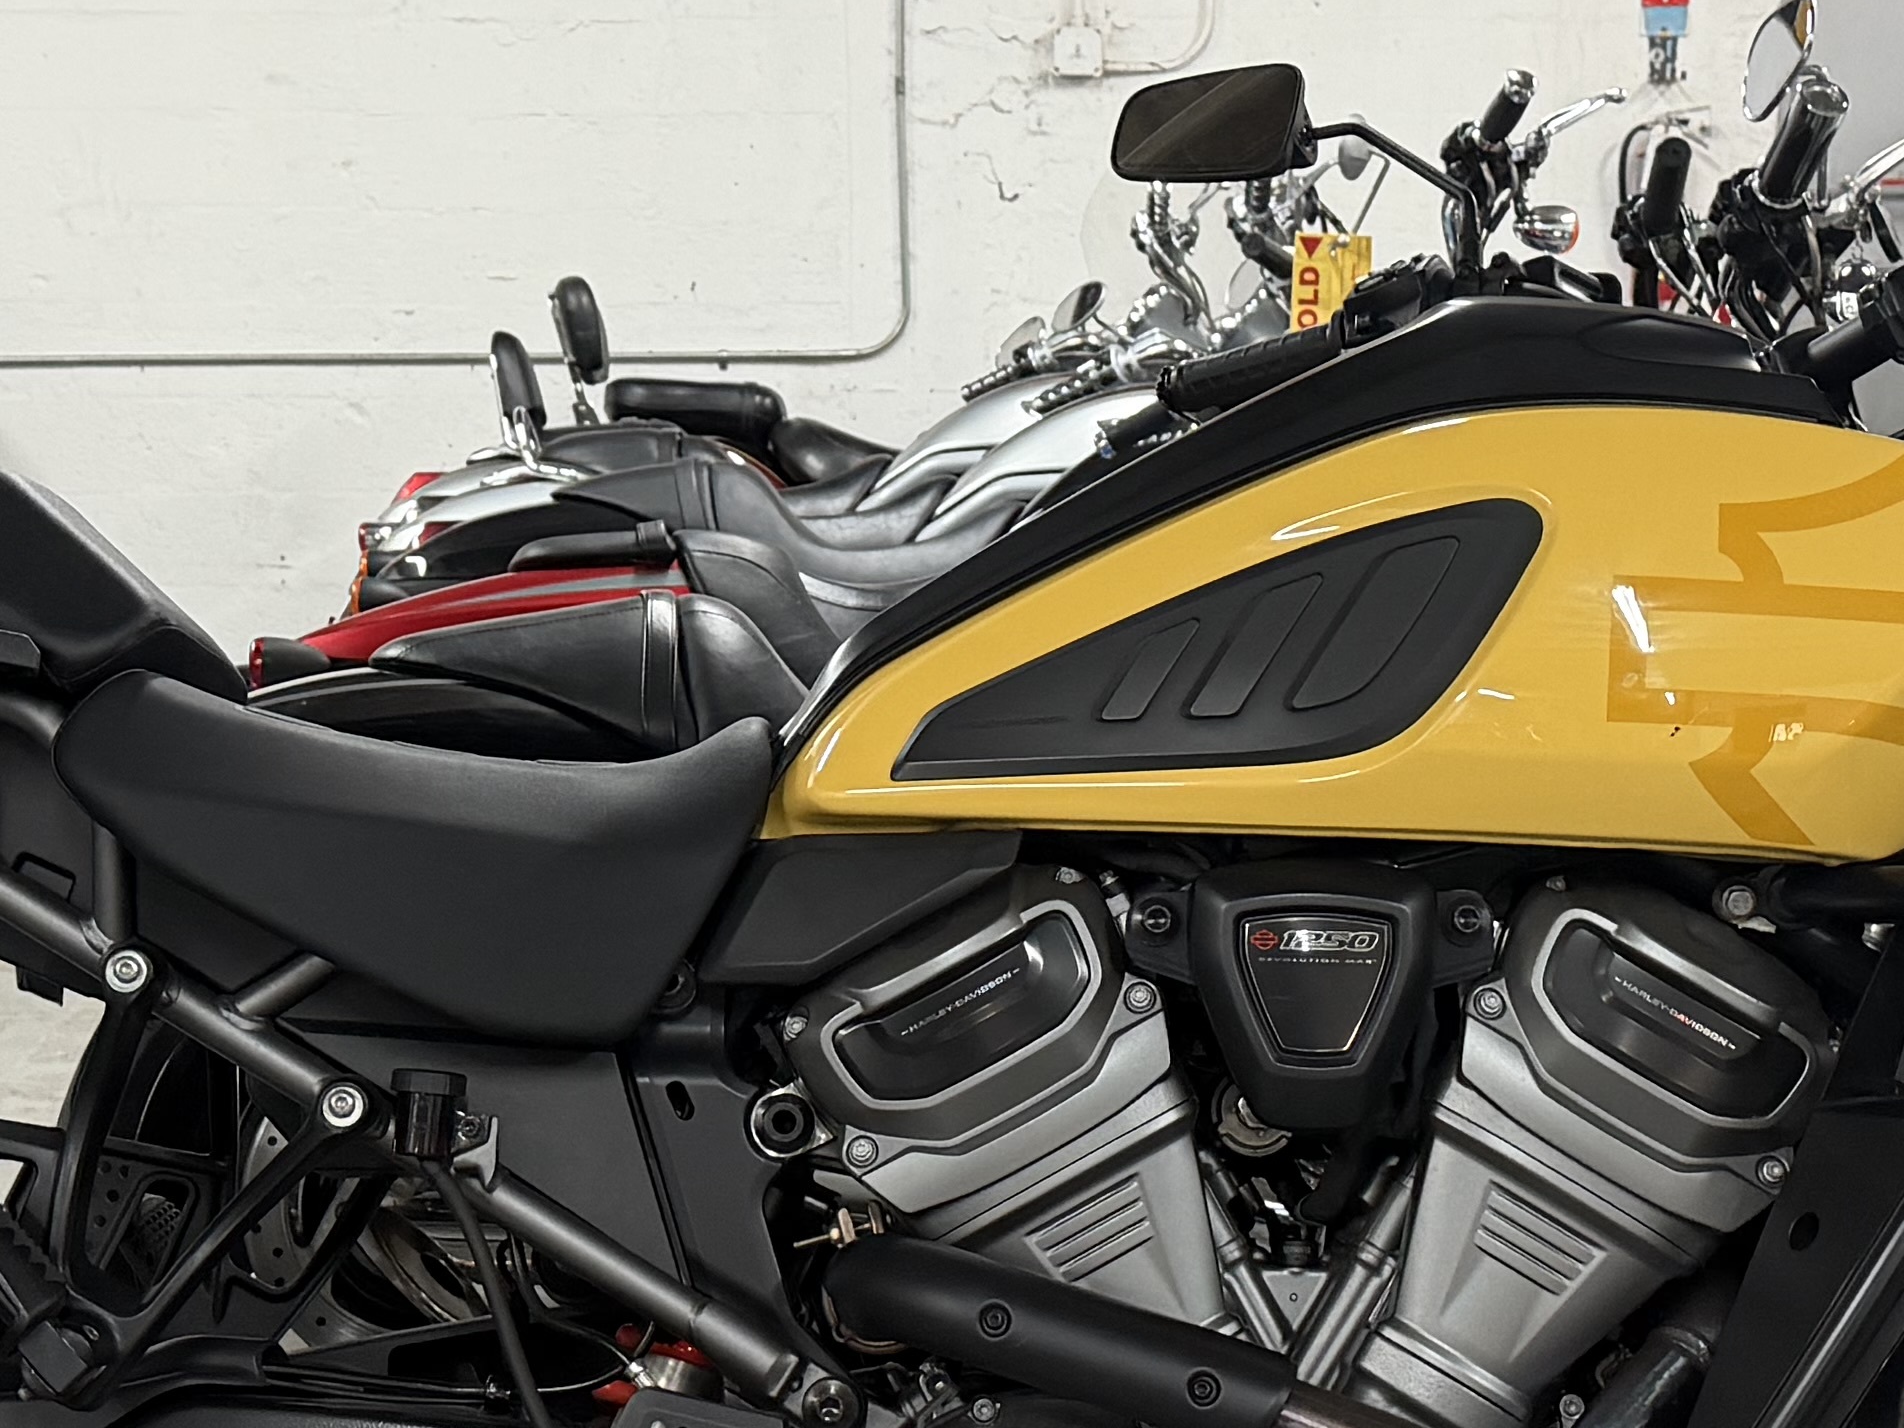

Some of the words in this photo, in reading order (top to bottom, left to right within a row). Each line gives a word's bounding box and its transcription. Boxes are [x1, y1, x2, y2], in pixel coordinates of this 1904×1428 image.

[1297, 266, 1321, 329] OLD
[1279, 930, 1379, 952] 1250
[1622, 980, 1730, 1048] HARLEY-DAVIDSON
